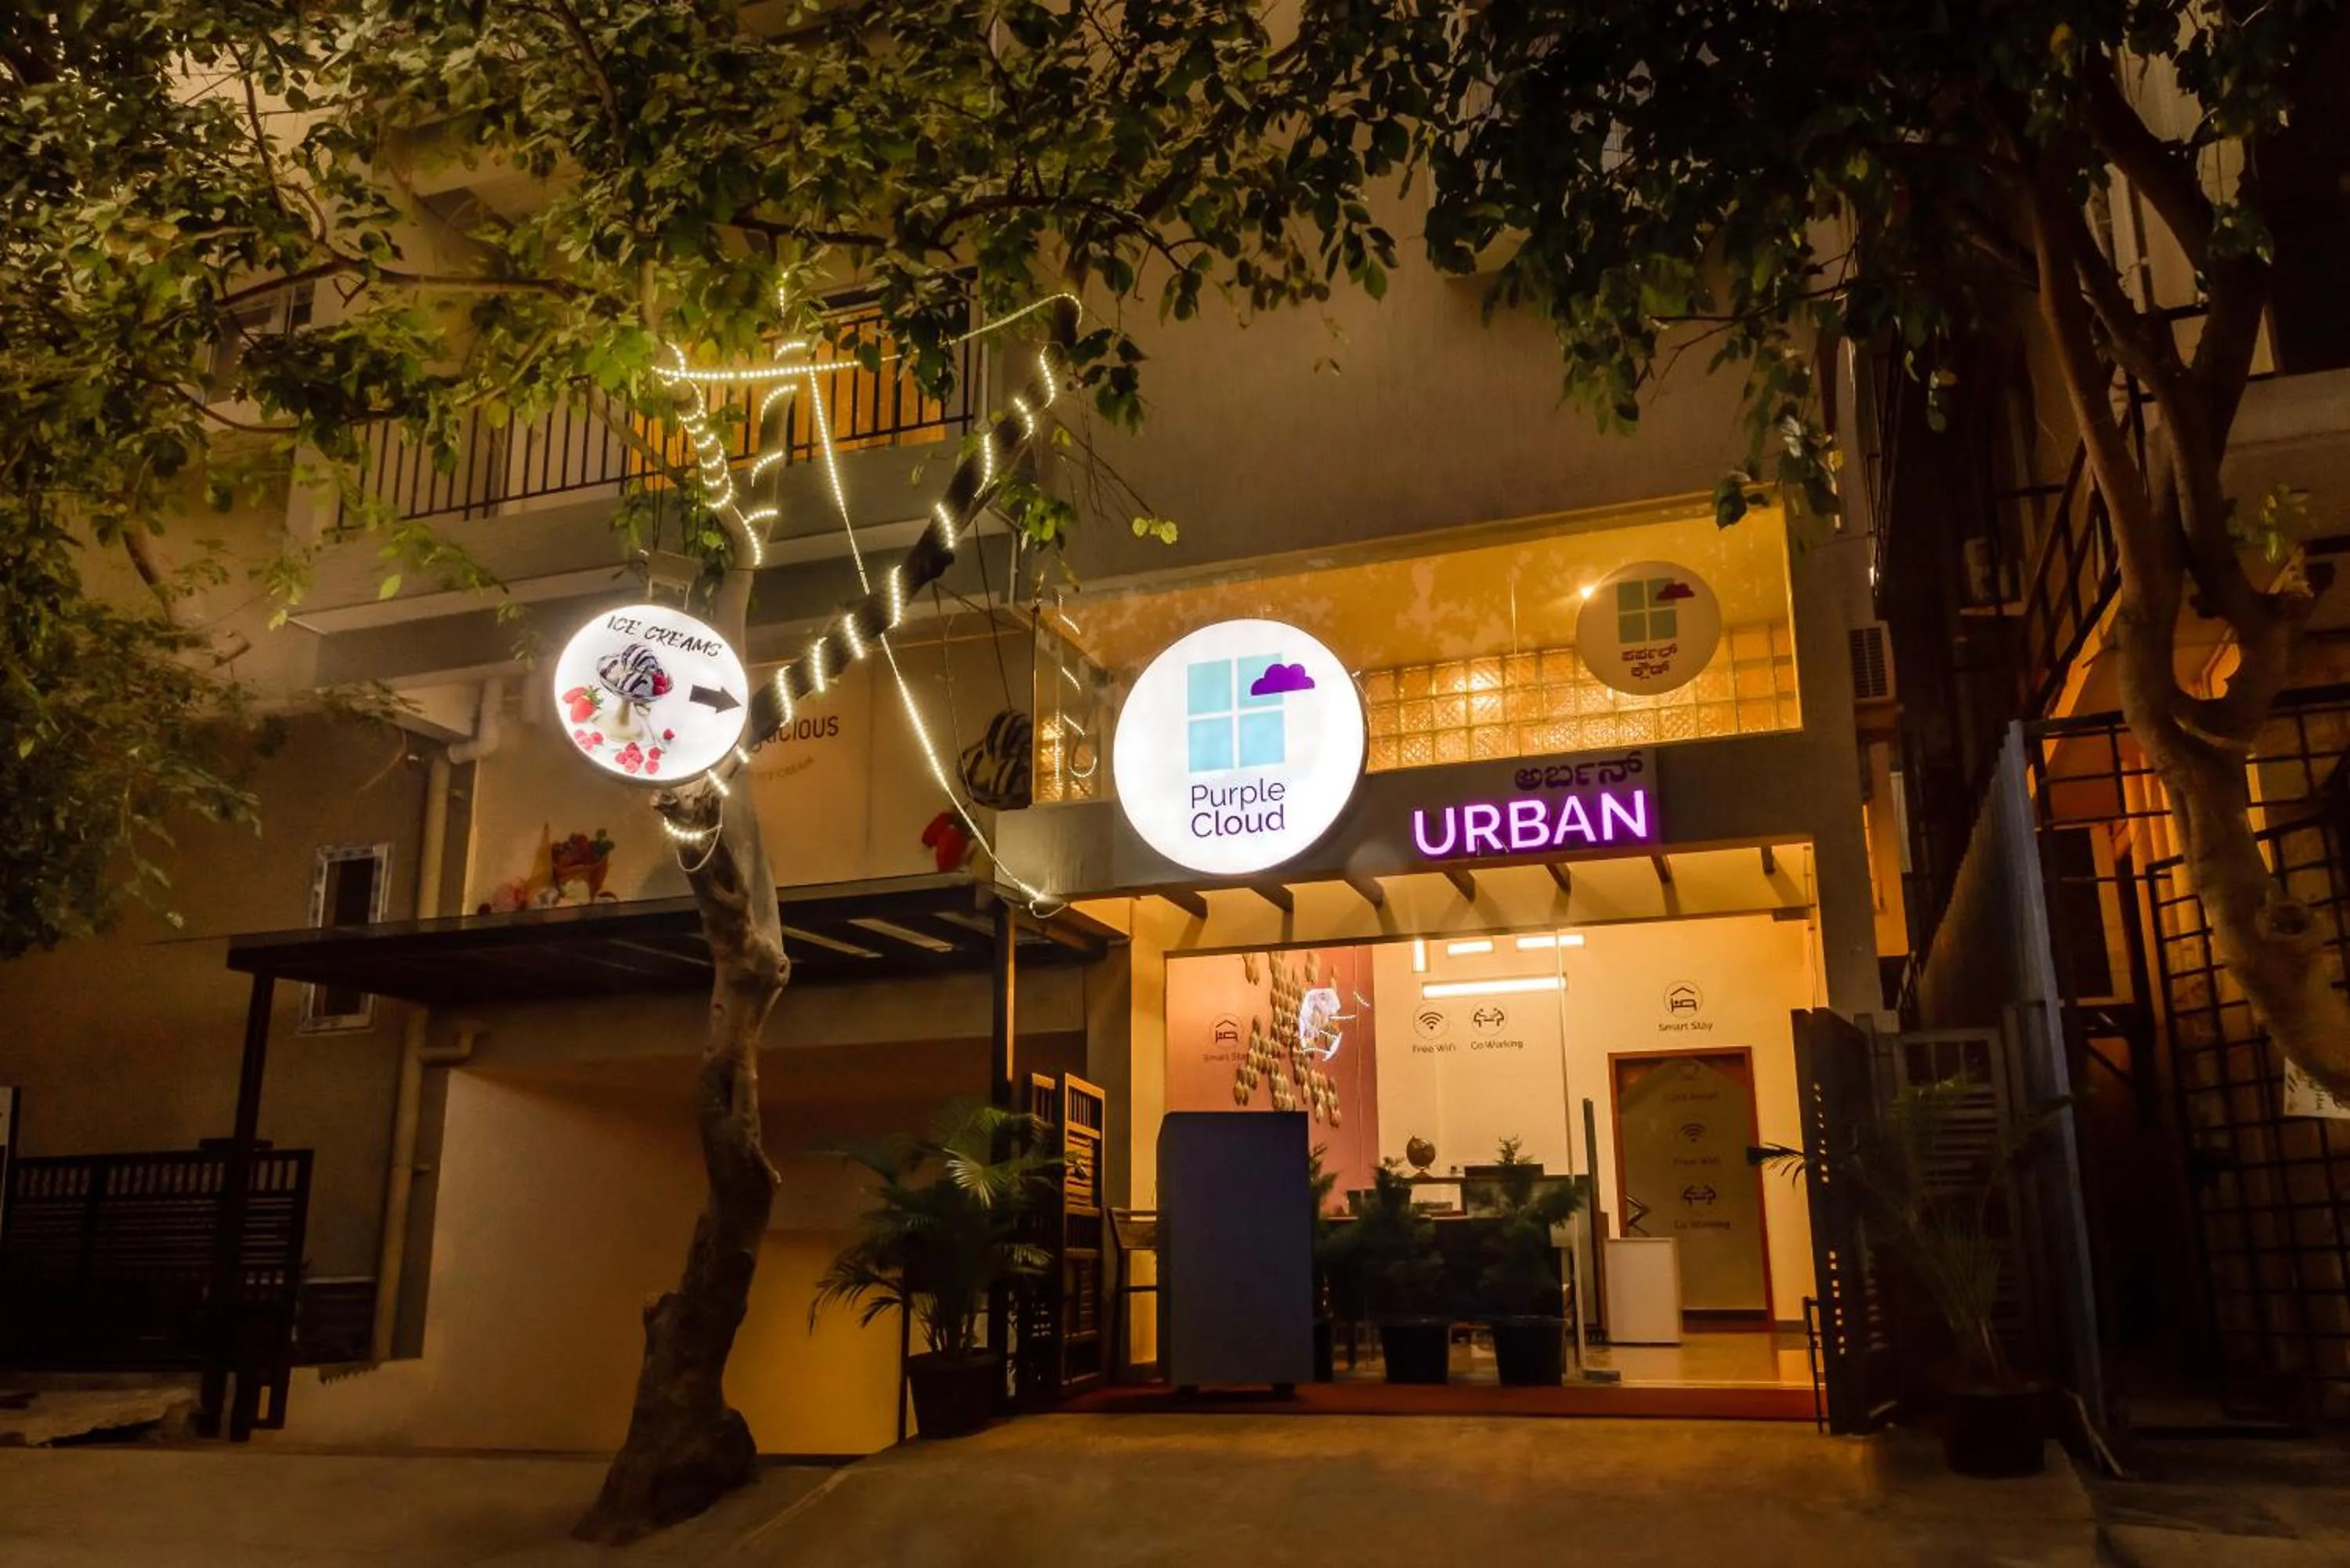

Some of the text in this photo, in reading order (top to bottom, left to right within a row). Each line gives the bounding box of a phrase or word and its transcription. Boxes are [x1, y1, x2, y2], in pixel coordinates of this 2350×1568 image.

[607, 615, 722, 657] ICE CREAMS
[1191, 779, 1285, 811] Purple
[1191, 804, 1285, 838] Cloud
[1414, 789, 1647, 855] URBAN
[1690, 1021, 1714, 1031] Stay
